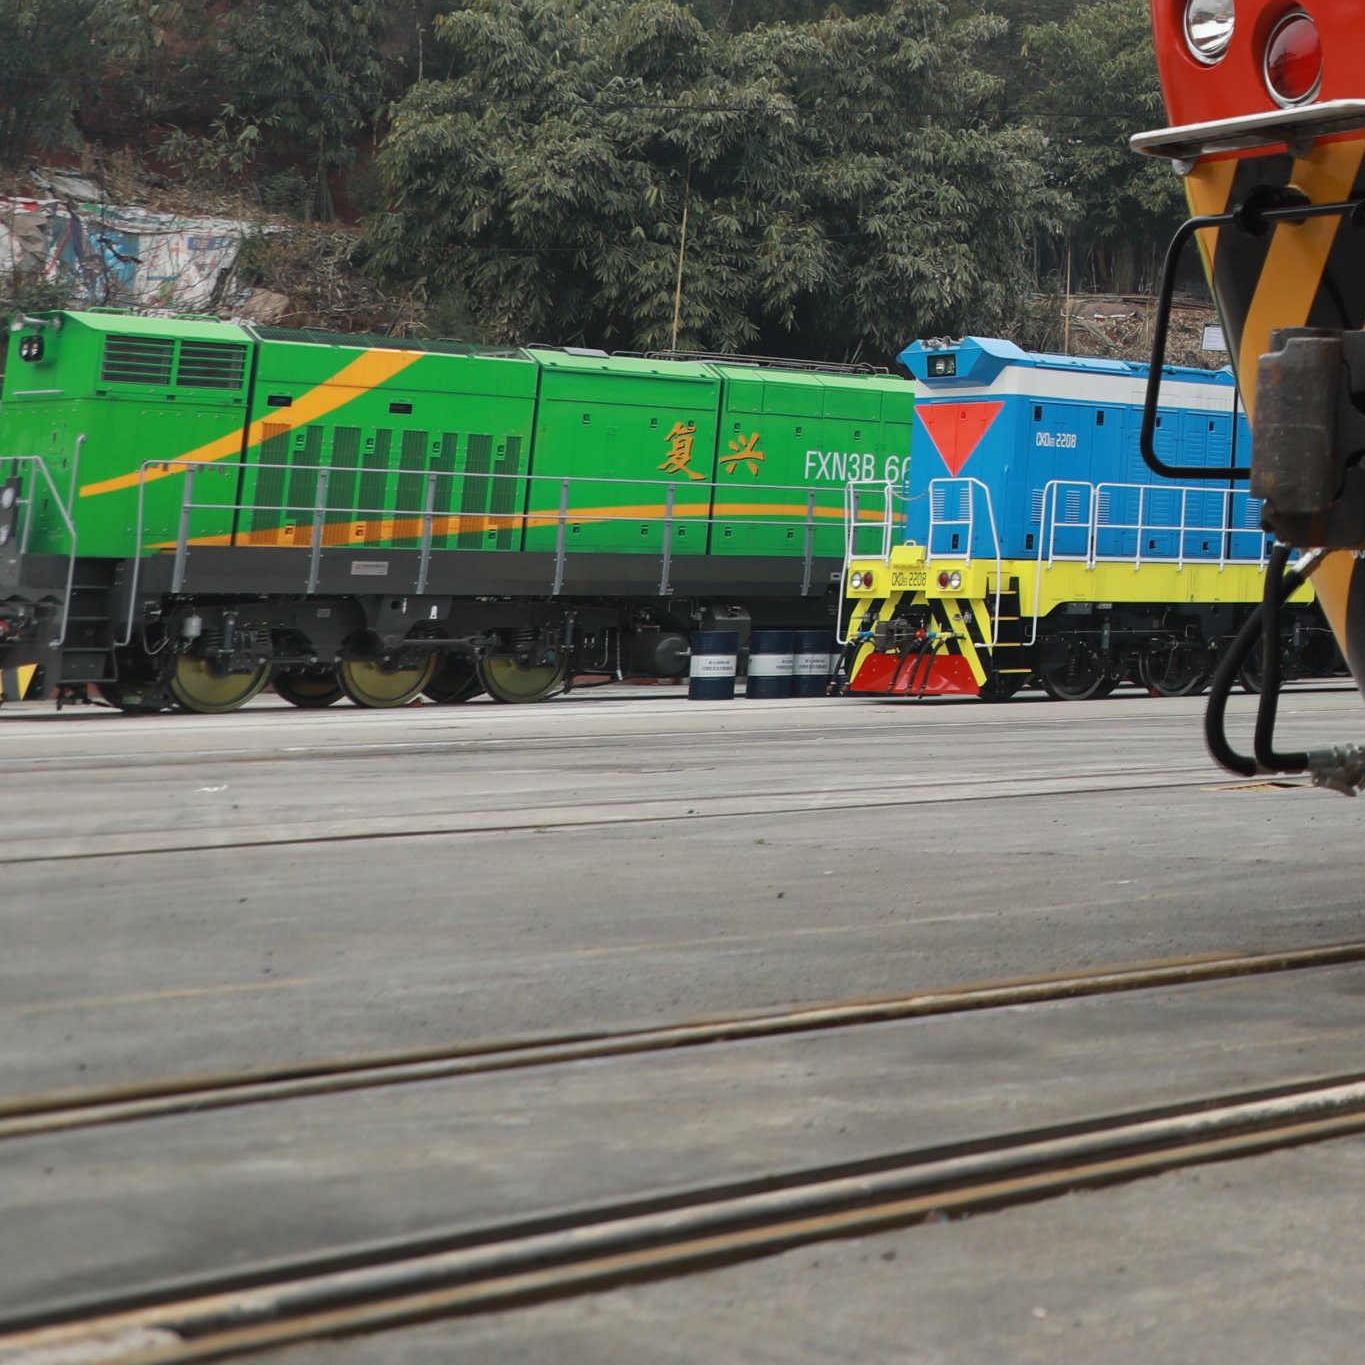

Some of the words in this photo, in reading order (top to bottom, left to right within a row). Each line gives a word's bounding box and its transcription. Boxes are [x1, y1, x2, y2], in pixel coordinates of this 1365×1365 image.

[657, 421, 765, 481] 复兴
[1056, 432, 1077, 449] 2208
[804, 450, 875, 482] FXN3B
[909, 571, 927, 587] 2208
